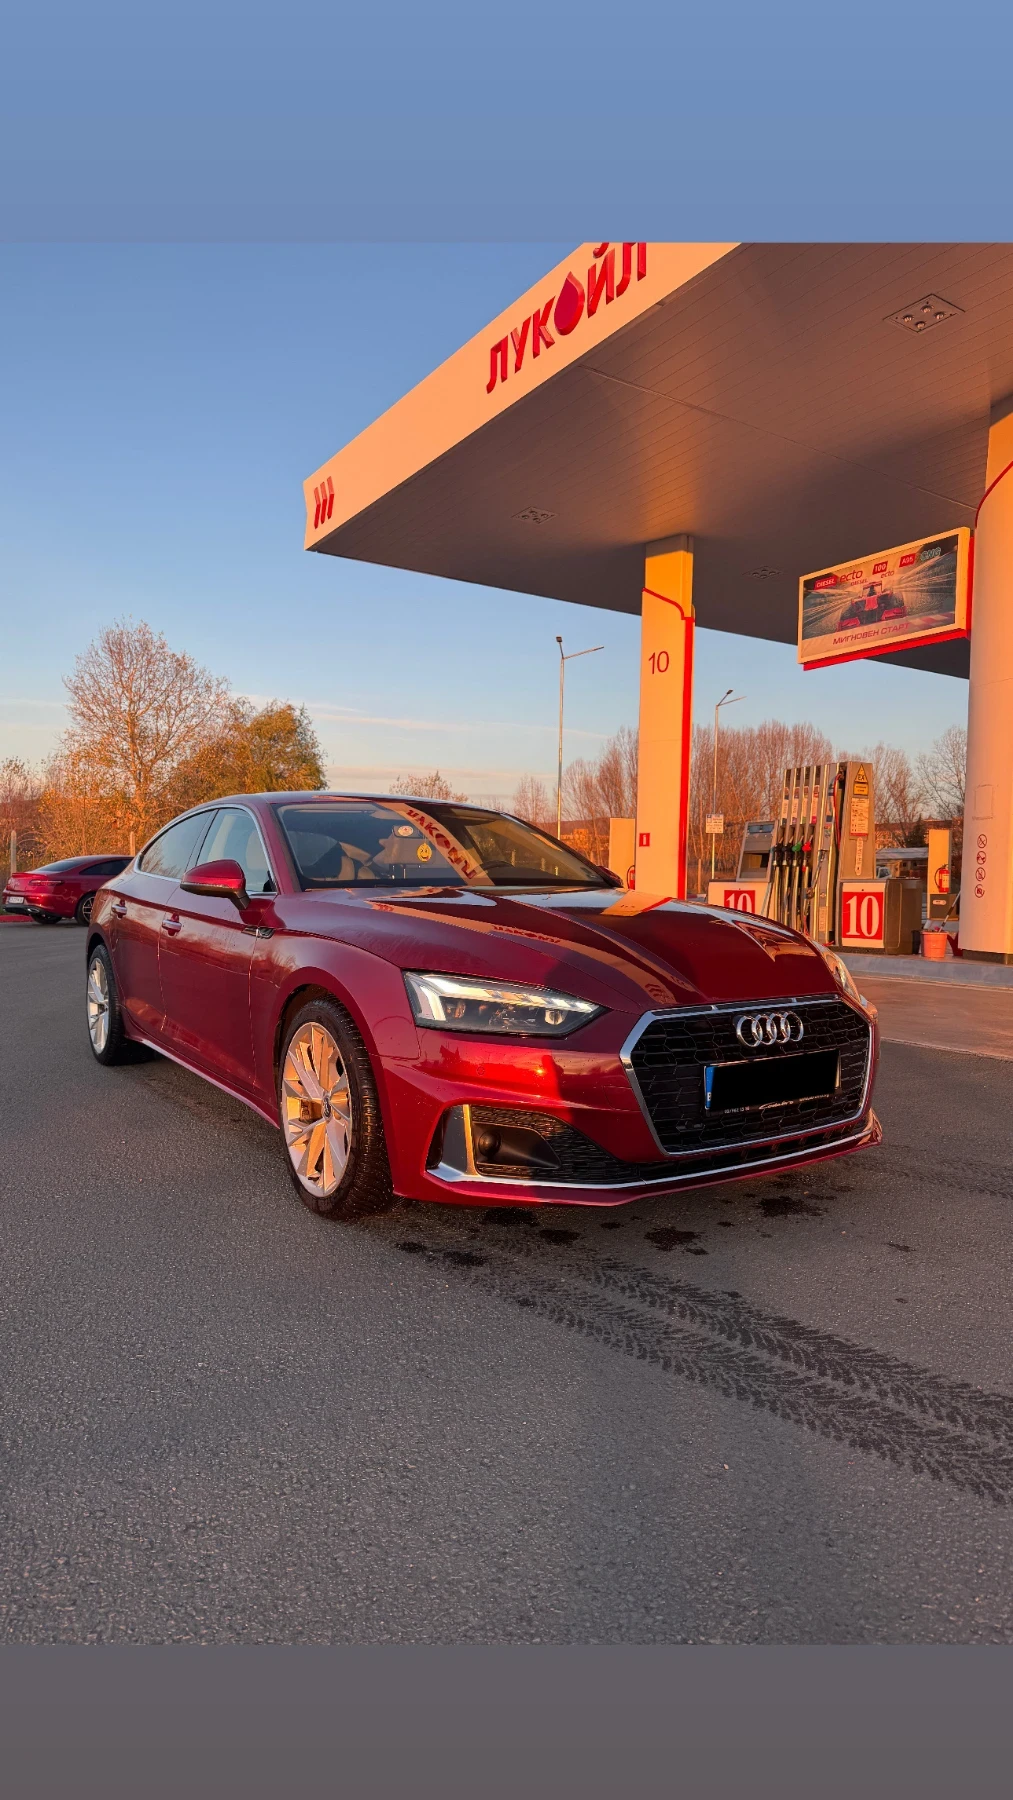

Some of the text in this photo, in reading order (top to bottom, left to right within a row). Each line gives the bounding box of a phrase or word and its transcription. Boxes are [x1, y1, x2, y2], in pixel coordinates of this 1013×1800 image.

[486, 242, 647, 394] ЛУКОЙЛ
[839, 570, 864, 583] ecto
[874, 563, 887, 573] 100
[880, 570, 895, 578] ecto
[816, 578, 835, 588] DIESEL
[832, 622, 911, 645] МИГНОВЕН СТАРТ
[648, 650, 670, 675] 10
[845, 895, 880, 937] 10
